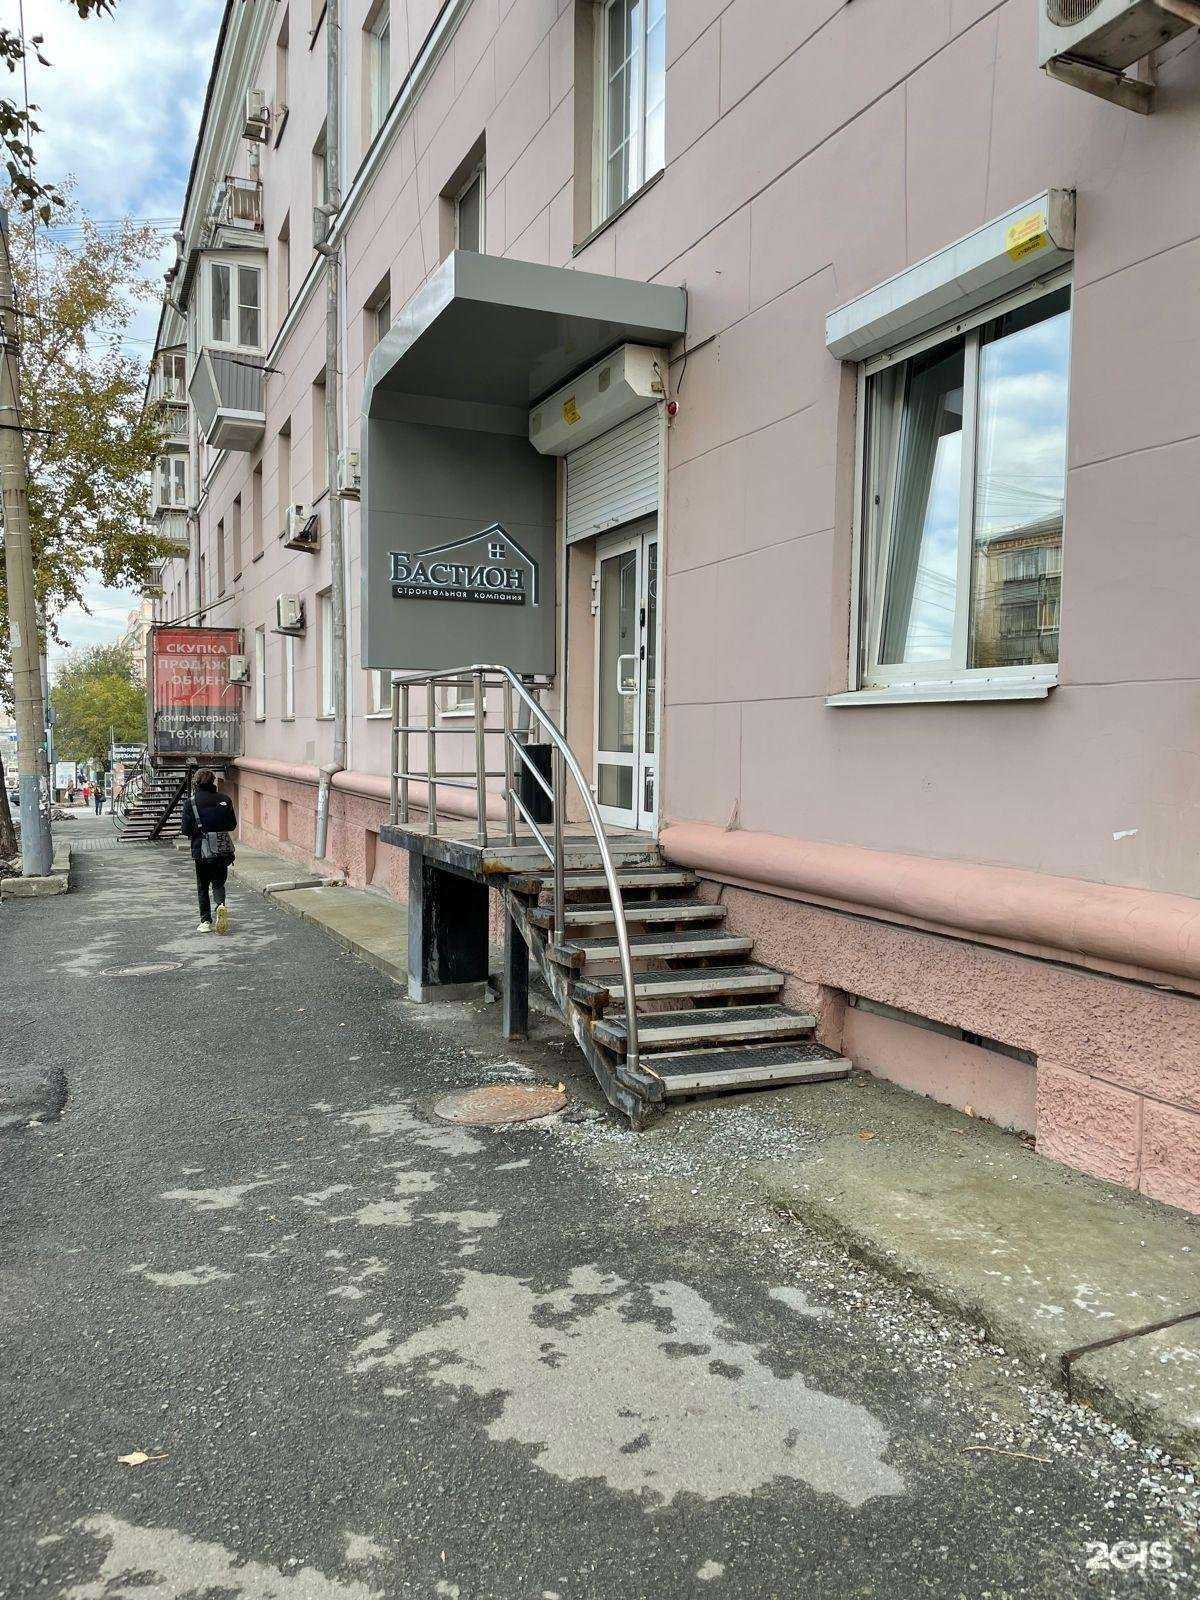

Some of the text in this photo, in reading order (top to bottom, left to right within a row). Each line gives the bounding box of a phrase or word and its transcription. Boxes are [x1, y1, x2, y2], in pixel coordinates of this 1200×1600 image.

[388, 551, 525, 590] БАСТИОН
[397, 586, 522, 602] строительная компания
[166, 643, 228, 654] СКУПКА
[158, 659, 227, 670] ПРОДАЖ
[172, 675, 225, 686] ОБМЕН
[159, 713, 239, 724] компьютерной
